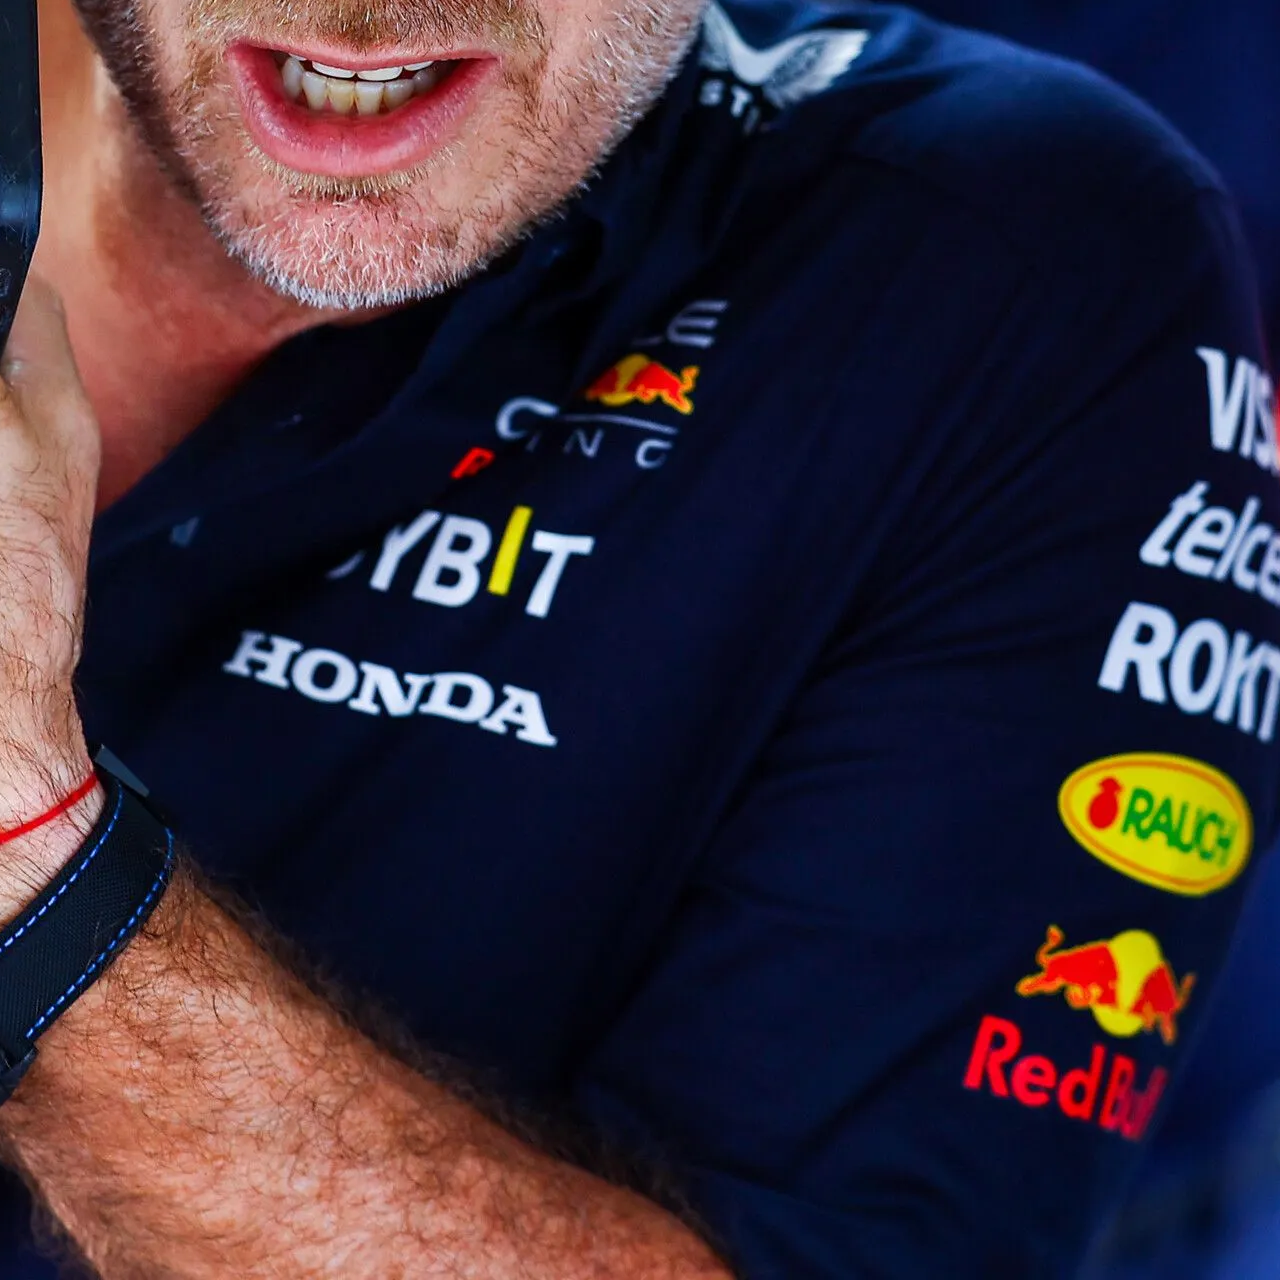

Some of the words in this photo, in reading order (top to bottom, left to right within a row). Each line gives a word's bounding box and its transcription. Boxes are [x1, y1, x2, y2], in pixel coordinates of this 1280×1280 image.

[326, 505, 596, 619] YBIT
[222, 629, 558, 747] HONDA
[1121, 786, 1238, 867] RAUCH
[962, 1015, 1105, 1121] Red
